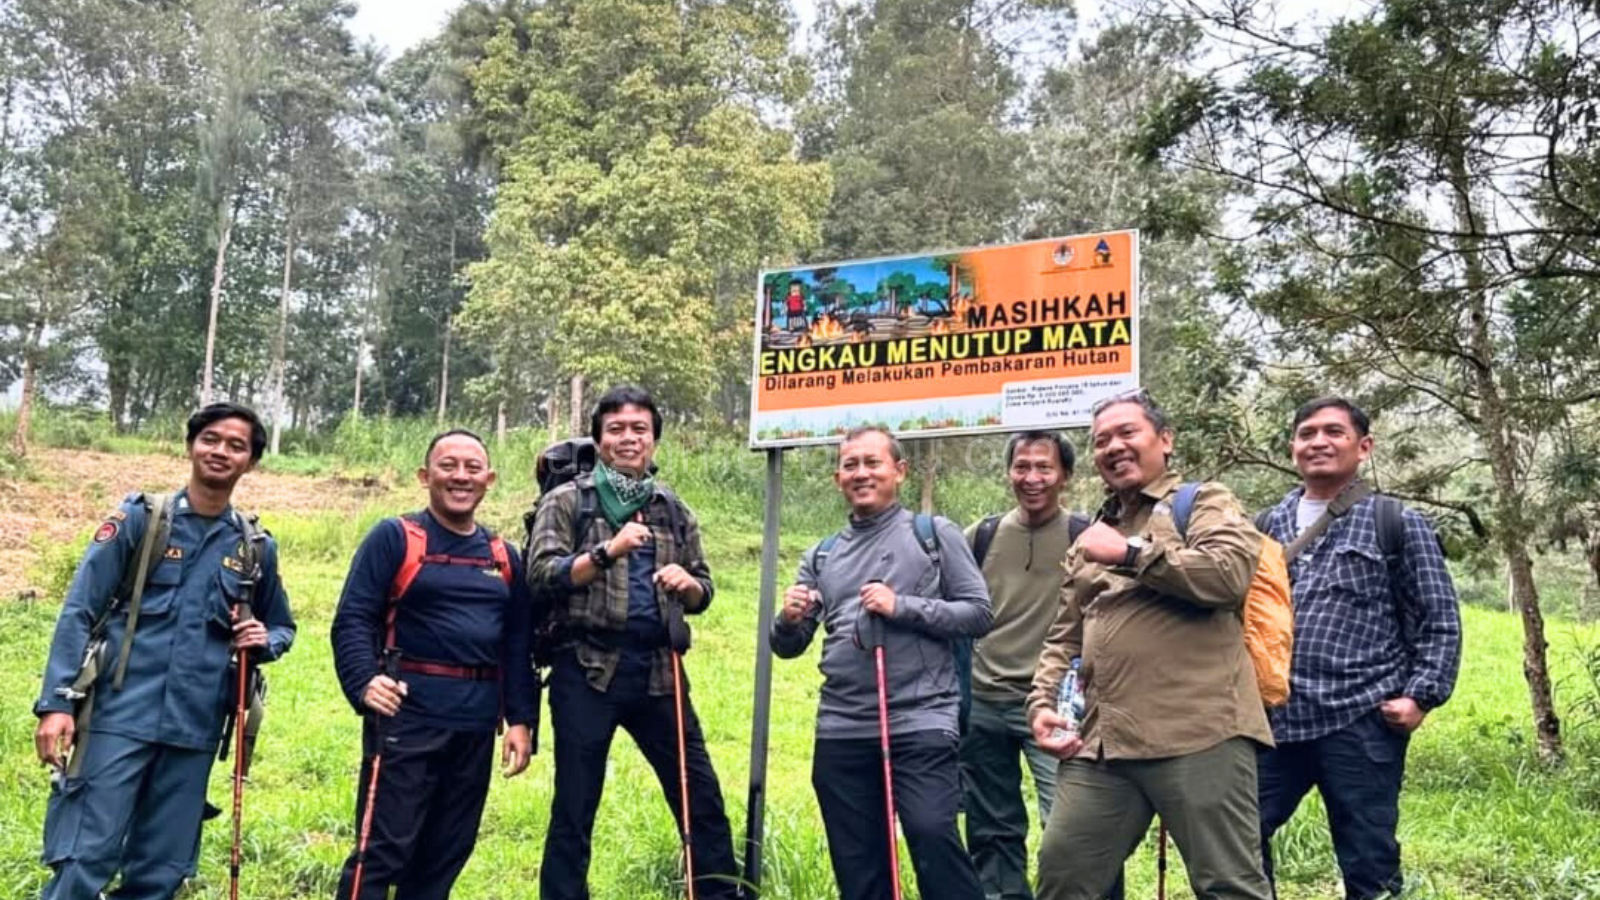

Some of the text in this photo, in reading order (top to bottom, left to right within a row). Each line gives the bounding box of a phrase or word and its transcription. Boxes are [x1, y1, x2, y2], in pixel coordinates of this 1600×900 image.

[967, 291, 1126, 328] MASIHKAH
[760, 319, 1130, 375] ENGKAU MENUTUP MATA
[765, 349, 1120, 391] Dilarang Melakukan Pembakaran Hutan
